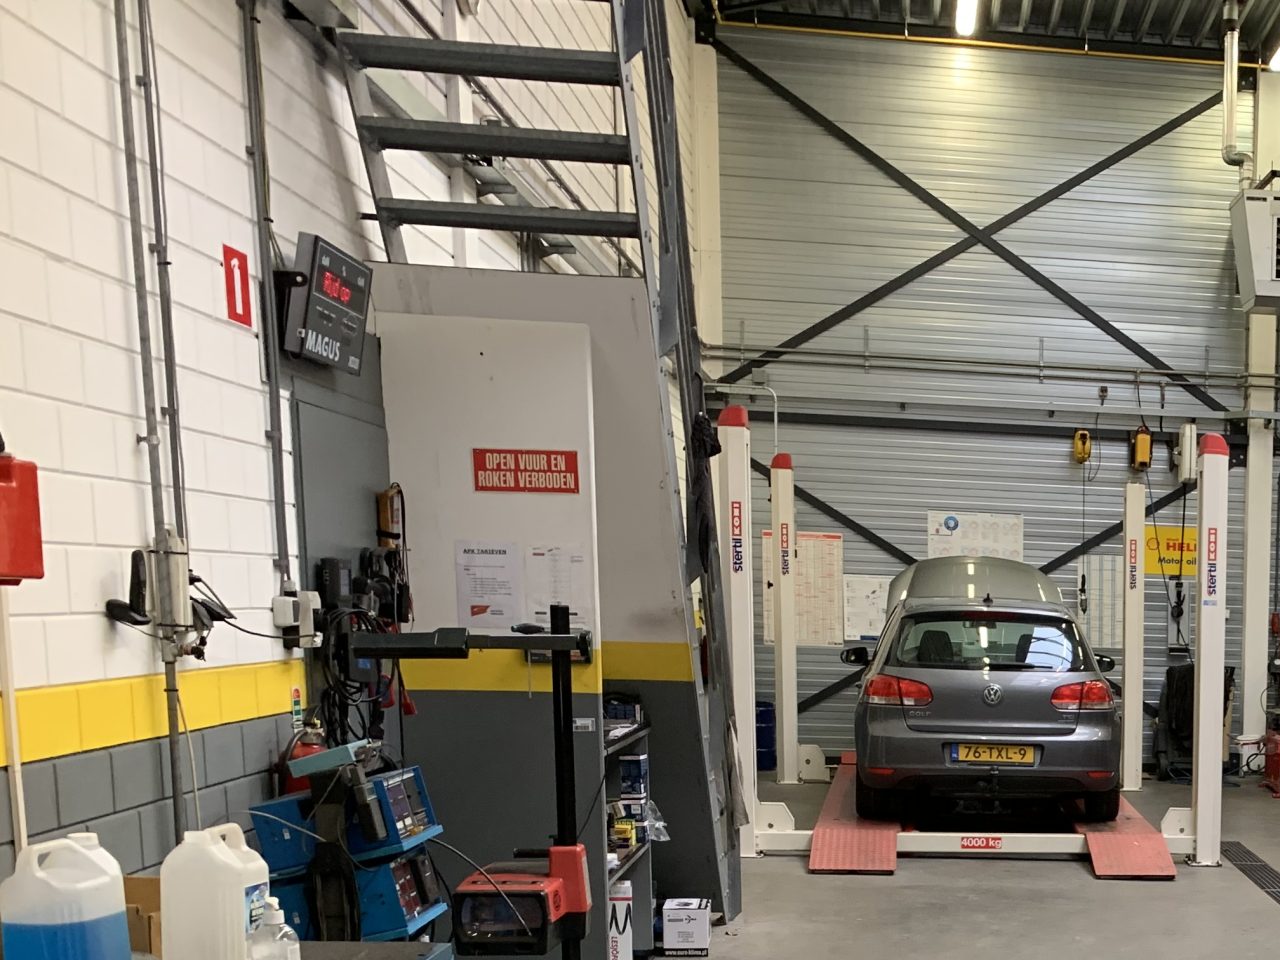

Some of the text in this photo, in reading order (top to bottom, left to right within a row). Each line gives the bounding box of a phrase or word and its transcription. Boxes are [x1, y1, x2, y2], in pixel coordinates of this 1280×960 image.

[306, 329, 340, 362] MAGUS
[485, 453, 566, 471] OPEN VUUR EN
[478, 470, 575, 489] ROKEN VERBODEN
[731, 502, 743, 573] stertil KONI
[1166, 542, 1197, 552] HELI
[1209, 529, 1217, 560] KONI
[781, 549, 790, 576] stertil
[1129, 565, 1137, 590] stertil
[1207, 562, 1217, 596] stertil
[964, 745, 1027, 760] 76-TXL-9
[961, 837, 1002, 849] 4000 kg
